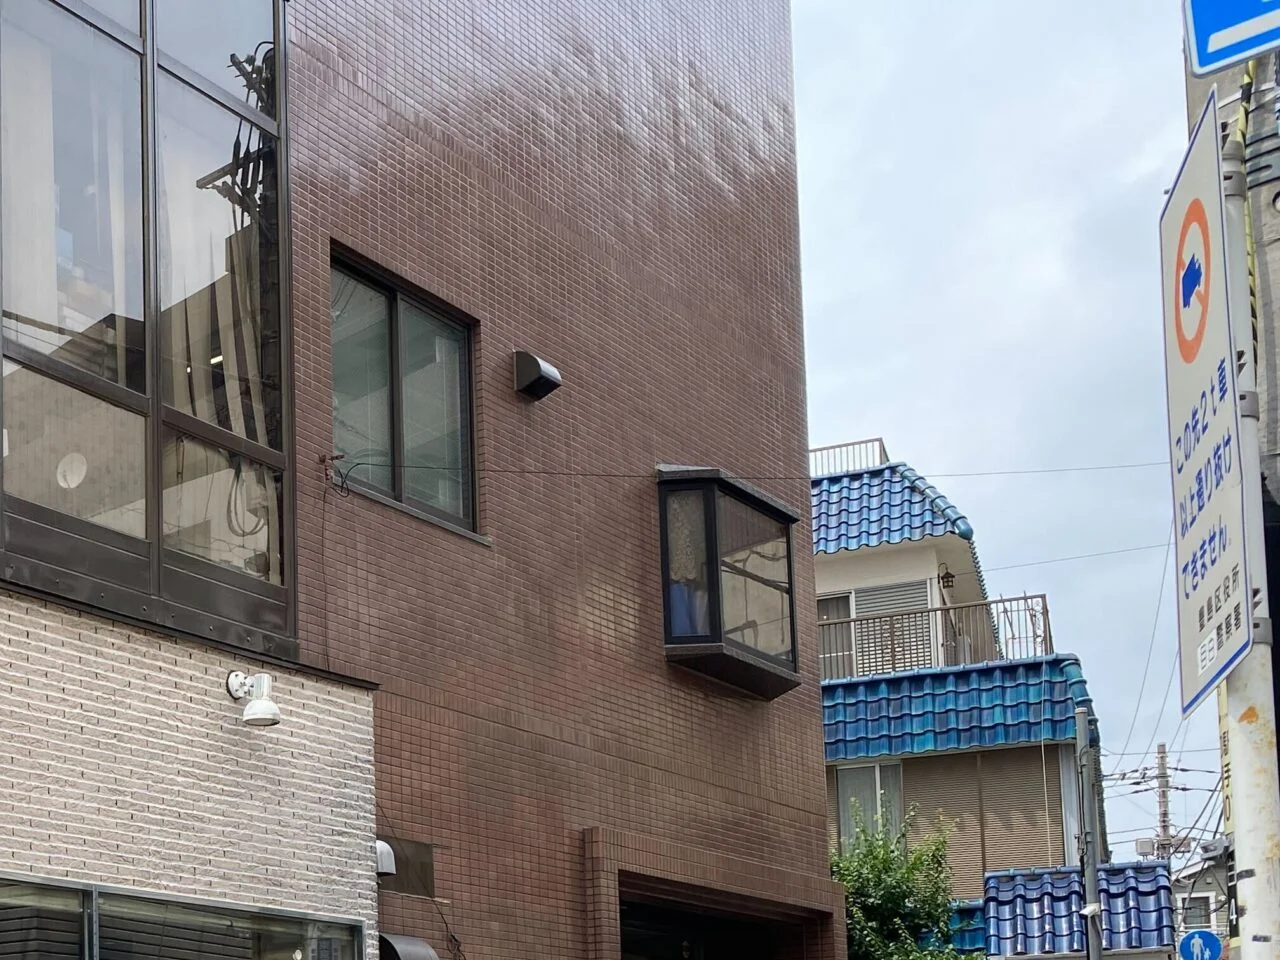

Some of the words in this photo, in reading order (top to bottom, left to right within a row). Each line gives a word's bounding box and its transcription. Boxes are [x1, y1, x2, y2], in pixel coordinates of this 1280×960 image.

[1179, 426, 1232, 540] 以上通り抜け
